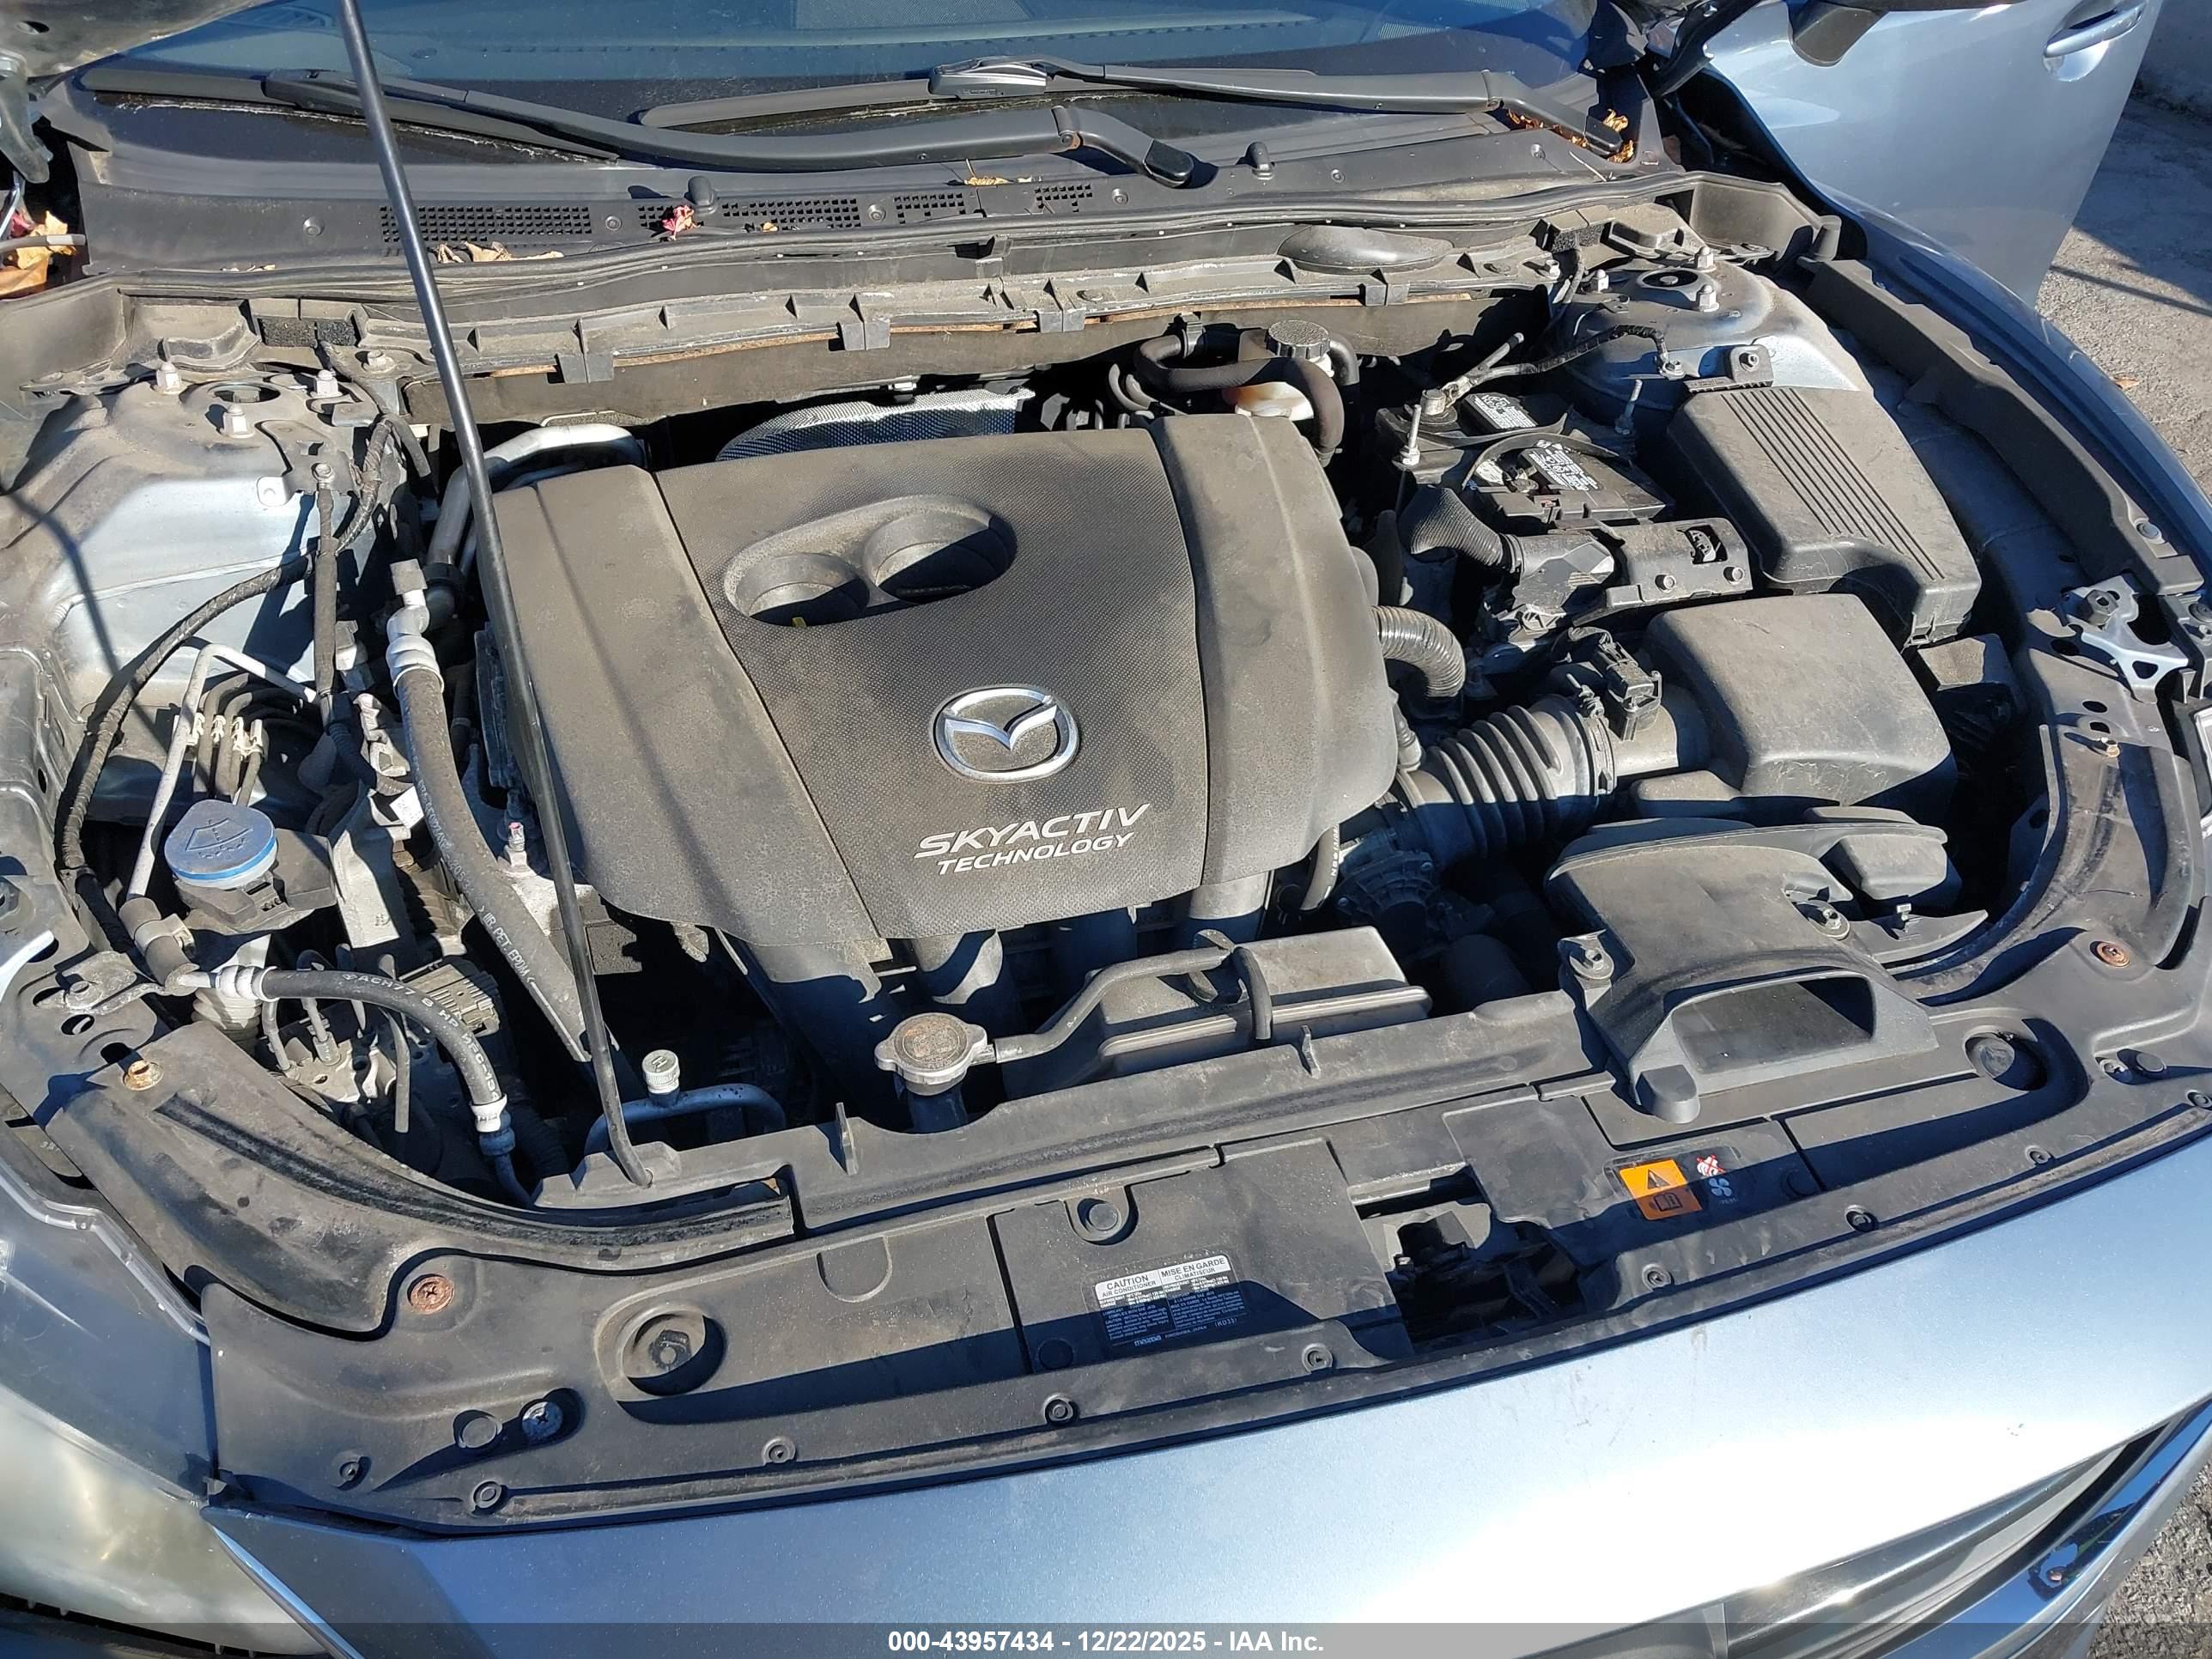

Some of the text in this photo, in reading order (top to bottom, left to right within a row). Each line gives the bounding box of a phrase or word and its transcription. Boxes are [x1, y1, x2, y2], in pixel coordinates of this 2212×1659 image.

[914, 804, 1151, 859] SKYACTIV
[936, 832, 1135, 875] TECHNOLOGY
[1161, 1258, 1226, 1278] MISE EN GARDE
[1107, 1274, 1149, 1290] CAUTION
[1114, 1280, 1157, 1295] CONDITIONER
